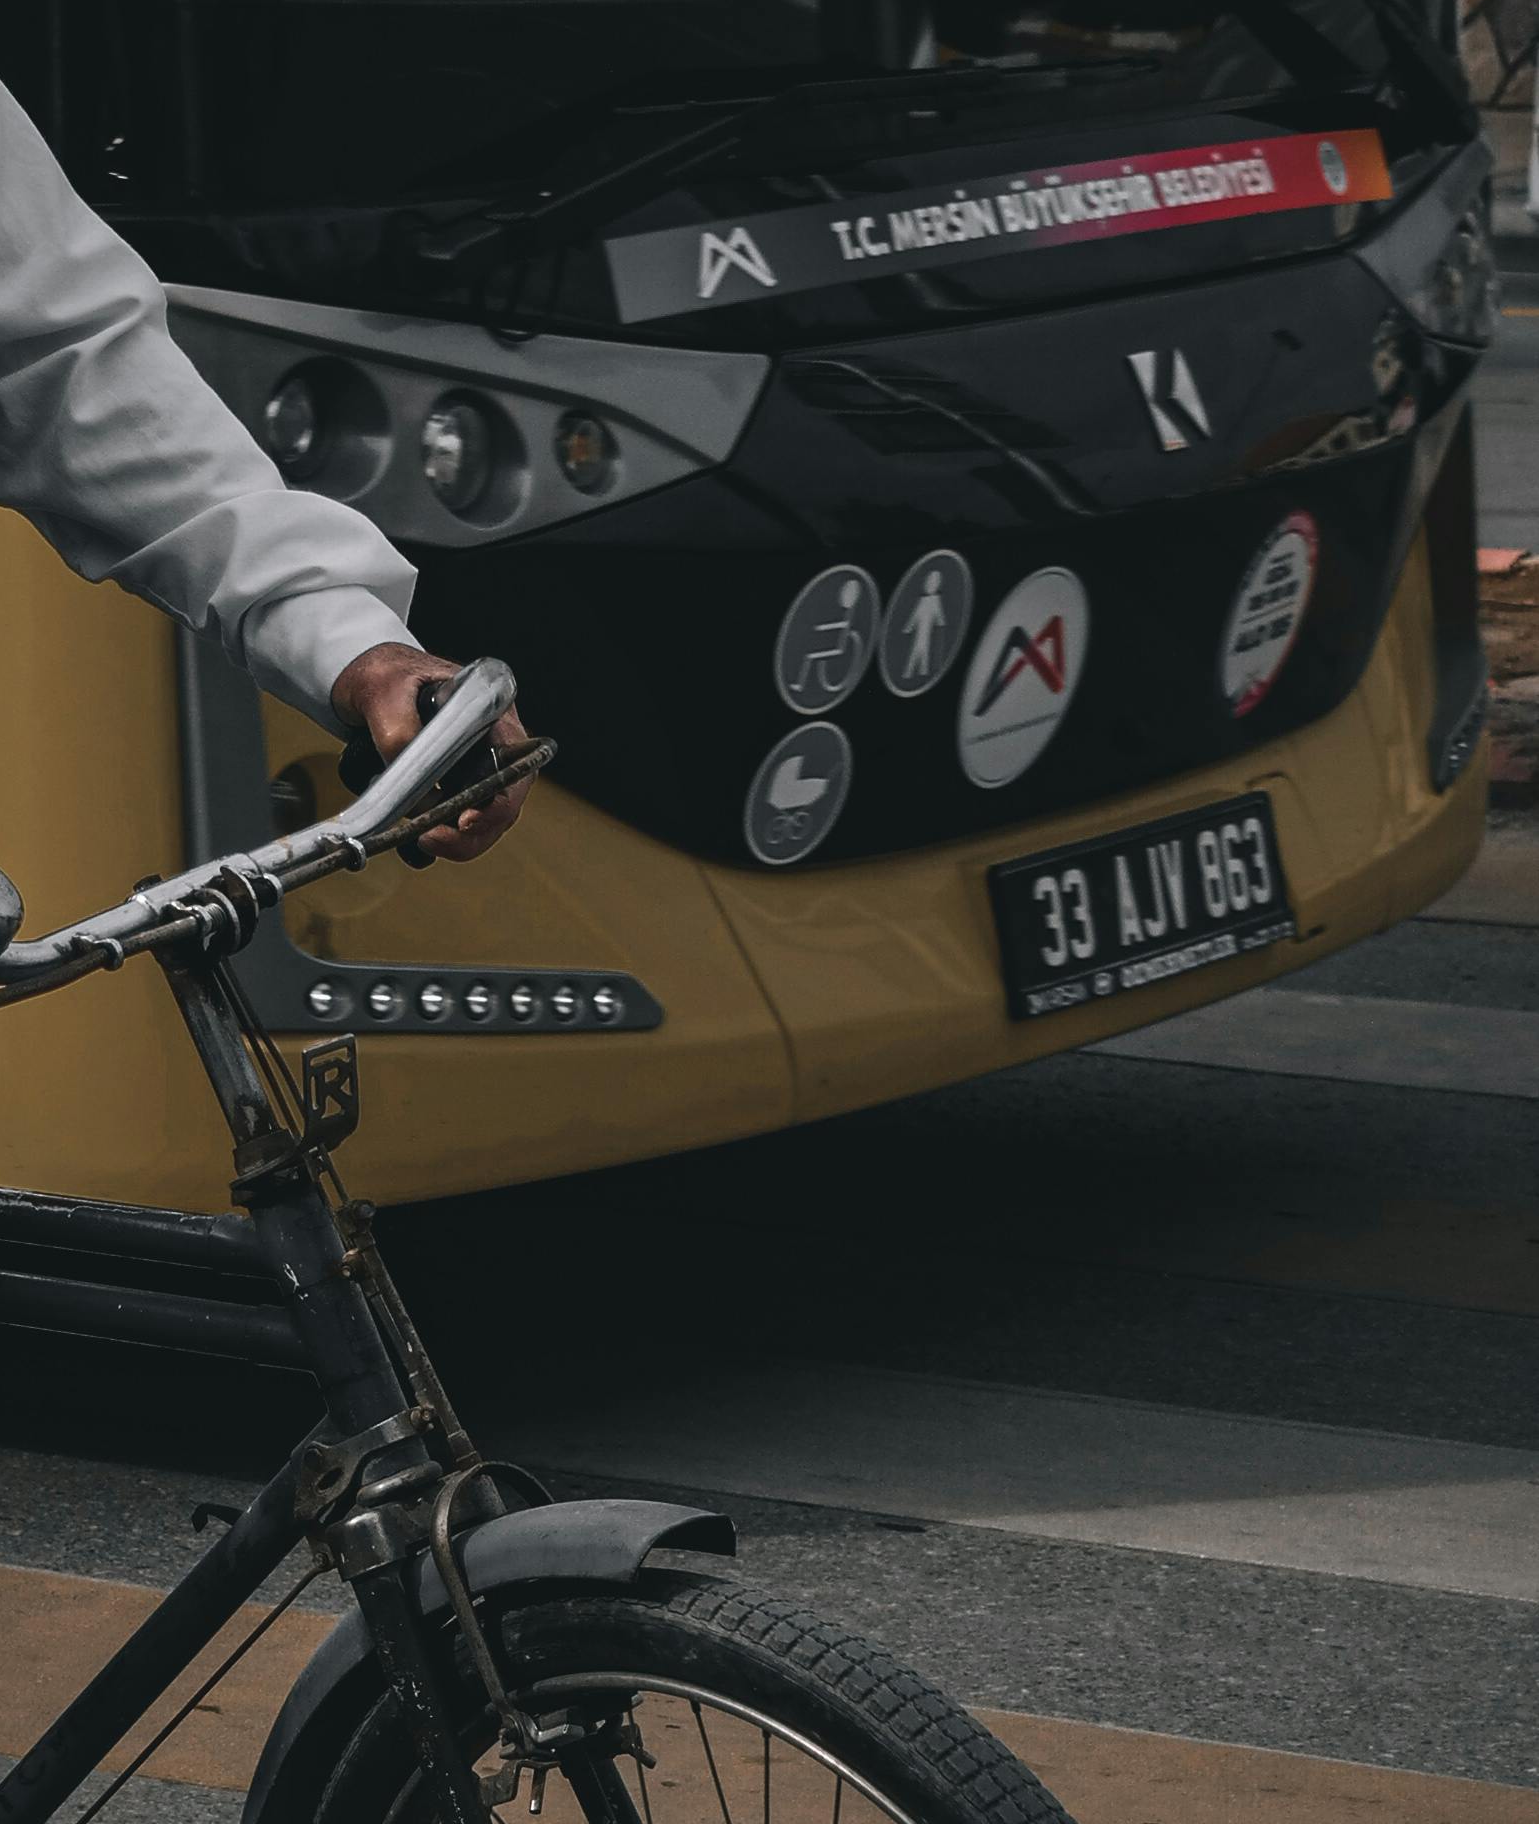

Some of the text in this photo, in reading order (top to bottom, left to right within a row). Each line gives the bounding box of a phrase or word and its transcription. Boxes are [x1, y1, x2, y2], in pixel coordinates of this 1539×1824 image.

[829, 147, 1276, 261] T.C. MERSİN BÜYÜKŞEHİR BELEDİYESİ
[1032, 868, 1096, 967] 33
[1114, 839, 1188, 947] AJV
[1196, 817, 1273, 919] 863
